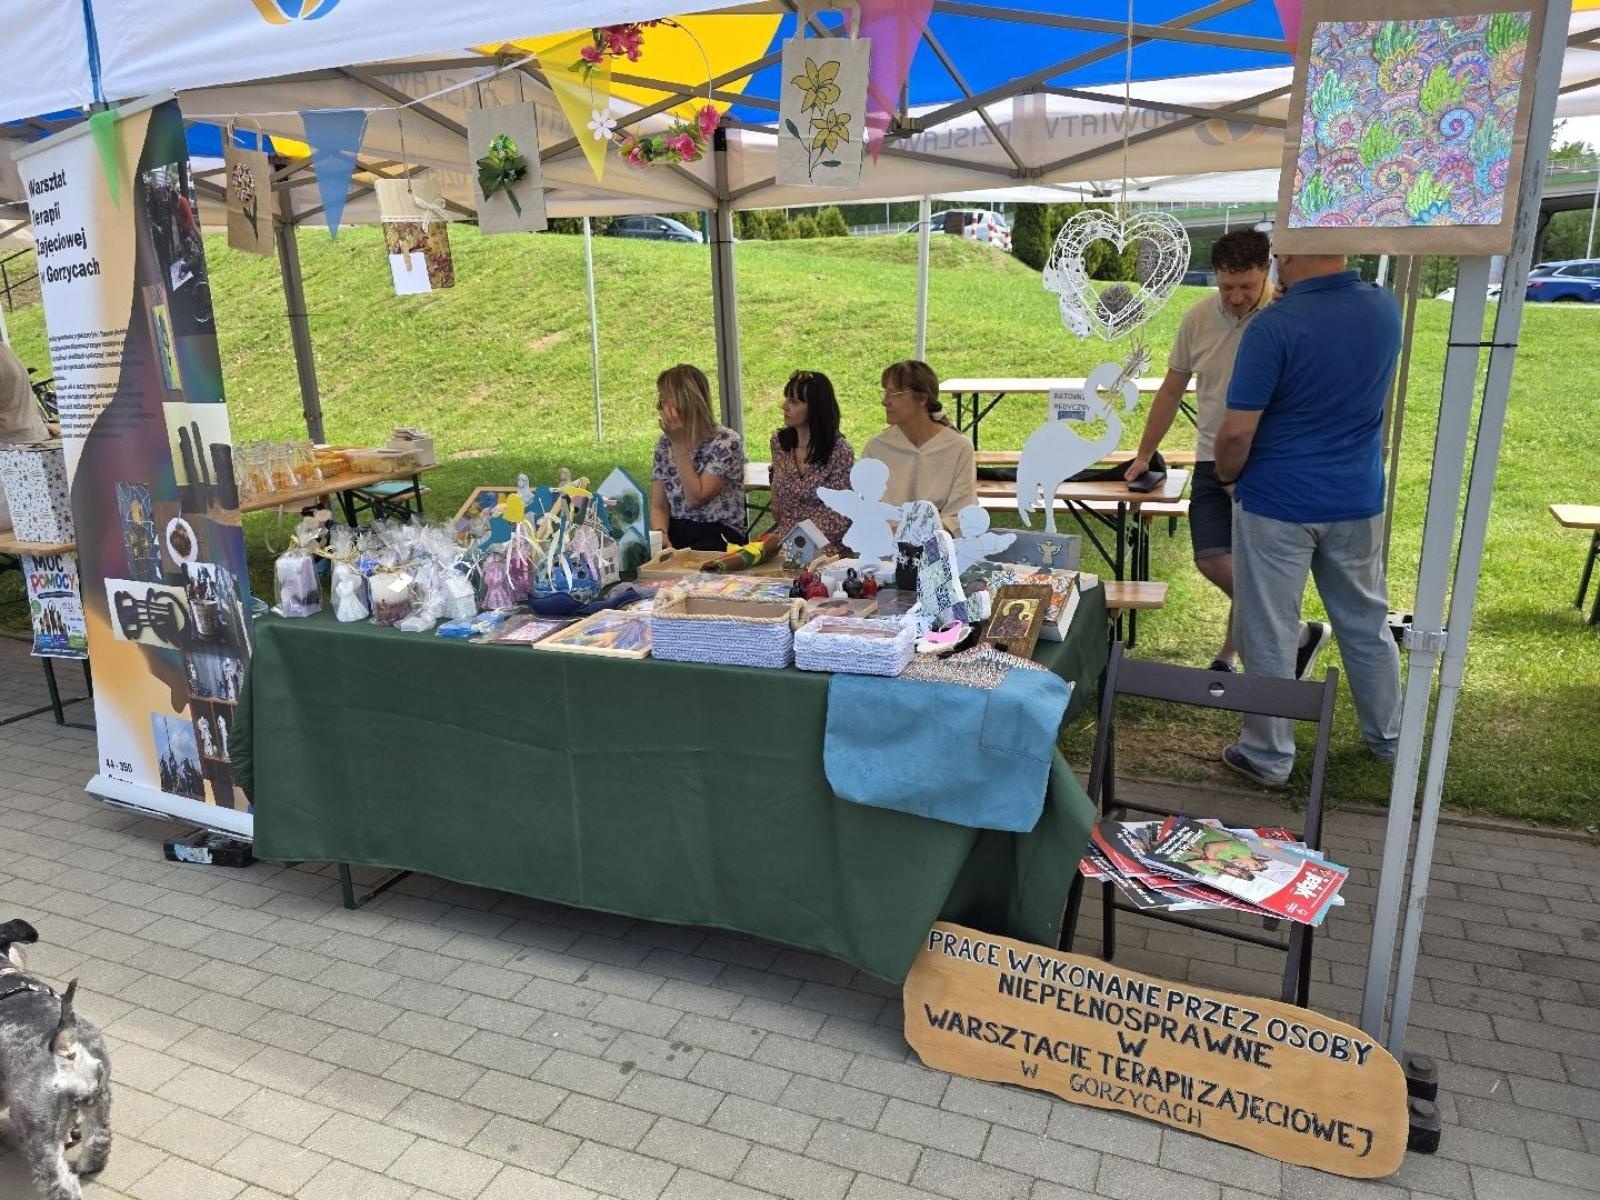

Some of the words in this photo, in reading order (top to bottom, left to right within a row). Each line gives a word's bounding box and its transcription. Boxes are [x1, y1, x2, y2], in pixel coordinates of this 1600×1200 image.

[29, 169, 67, 198] Warsztat
[35, 227, 87, 258] Zajęciowej
[46, 257, 100, 284] Gorzycach
[33, 555, 64, 573] MOC
[30, 573, 76, 593] POMOCY
[928, 929, 1001, 967] PRACE
[1007, 947, 1162, 1008] WYKONANE
[1166, 988, 1260, 1036] PRZEZ
[1266, 1017, 1373, 1067] OSOBY
[998, 972, 1274, 1070] NIEPEŁNOSPRAWNE
[1117, 1030, 1148, 1058] W
[924, 1002, 1092, 1071] WARSZTACIE
[1097, 1050, 1193, 1101] TERAPII
[1197, 1079, 1374, 1158] ZAJĘCIOWEJ
[1020, 1059, 1039, 1079] W
[1069, 1073, 1202, 1128] GORZYCACH
